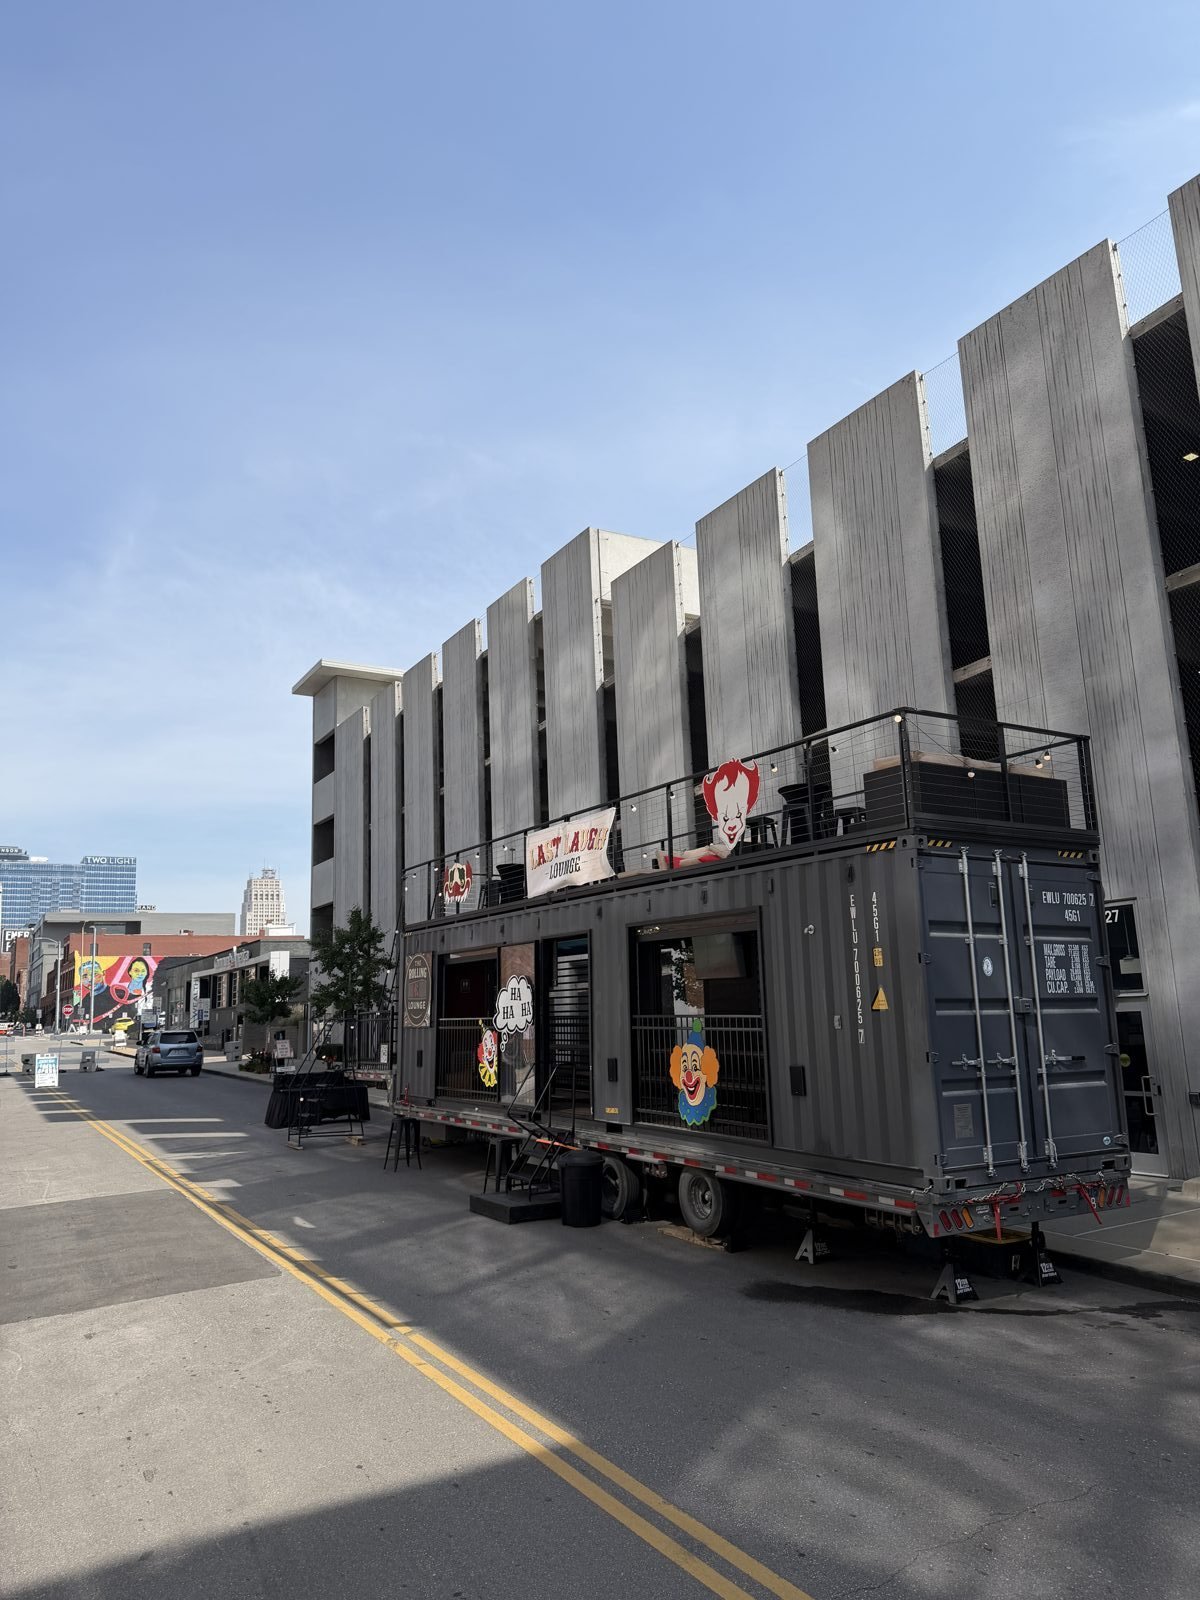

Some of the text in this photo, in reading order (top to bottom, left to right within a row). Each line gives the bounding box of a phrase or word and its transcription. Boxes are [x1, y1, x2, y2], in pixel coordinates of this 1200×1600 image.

[529, 827, 609, 870] LAST LAUGH
[86, 856, 136, 865] TWO LIGHT
[548, 856, 581, 880] LOUNGE
[1042, 891, 1060, 904] EWLU
[1062, 892, 1087, 906] 700625
[850, 894, 858, 944] EWLU
[871, 892, 880, 942] 45G1
[1064, 909, 1081, 922] 45G1
[1044, 956, 1056, 969] TARE
[408, 967, 428, 980] ROLLING
[1045, 968, 1066, 981] PAYLOAD
[1046, 981, 1070, 993] CU.CAP.
[510, 987, 521, 1001] HA
[408, 1001, 426, 1010] LOUNGE
[502, 1002, 532, 1019] HA HA
